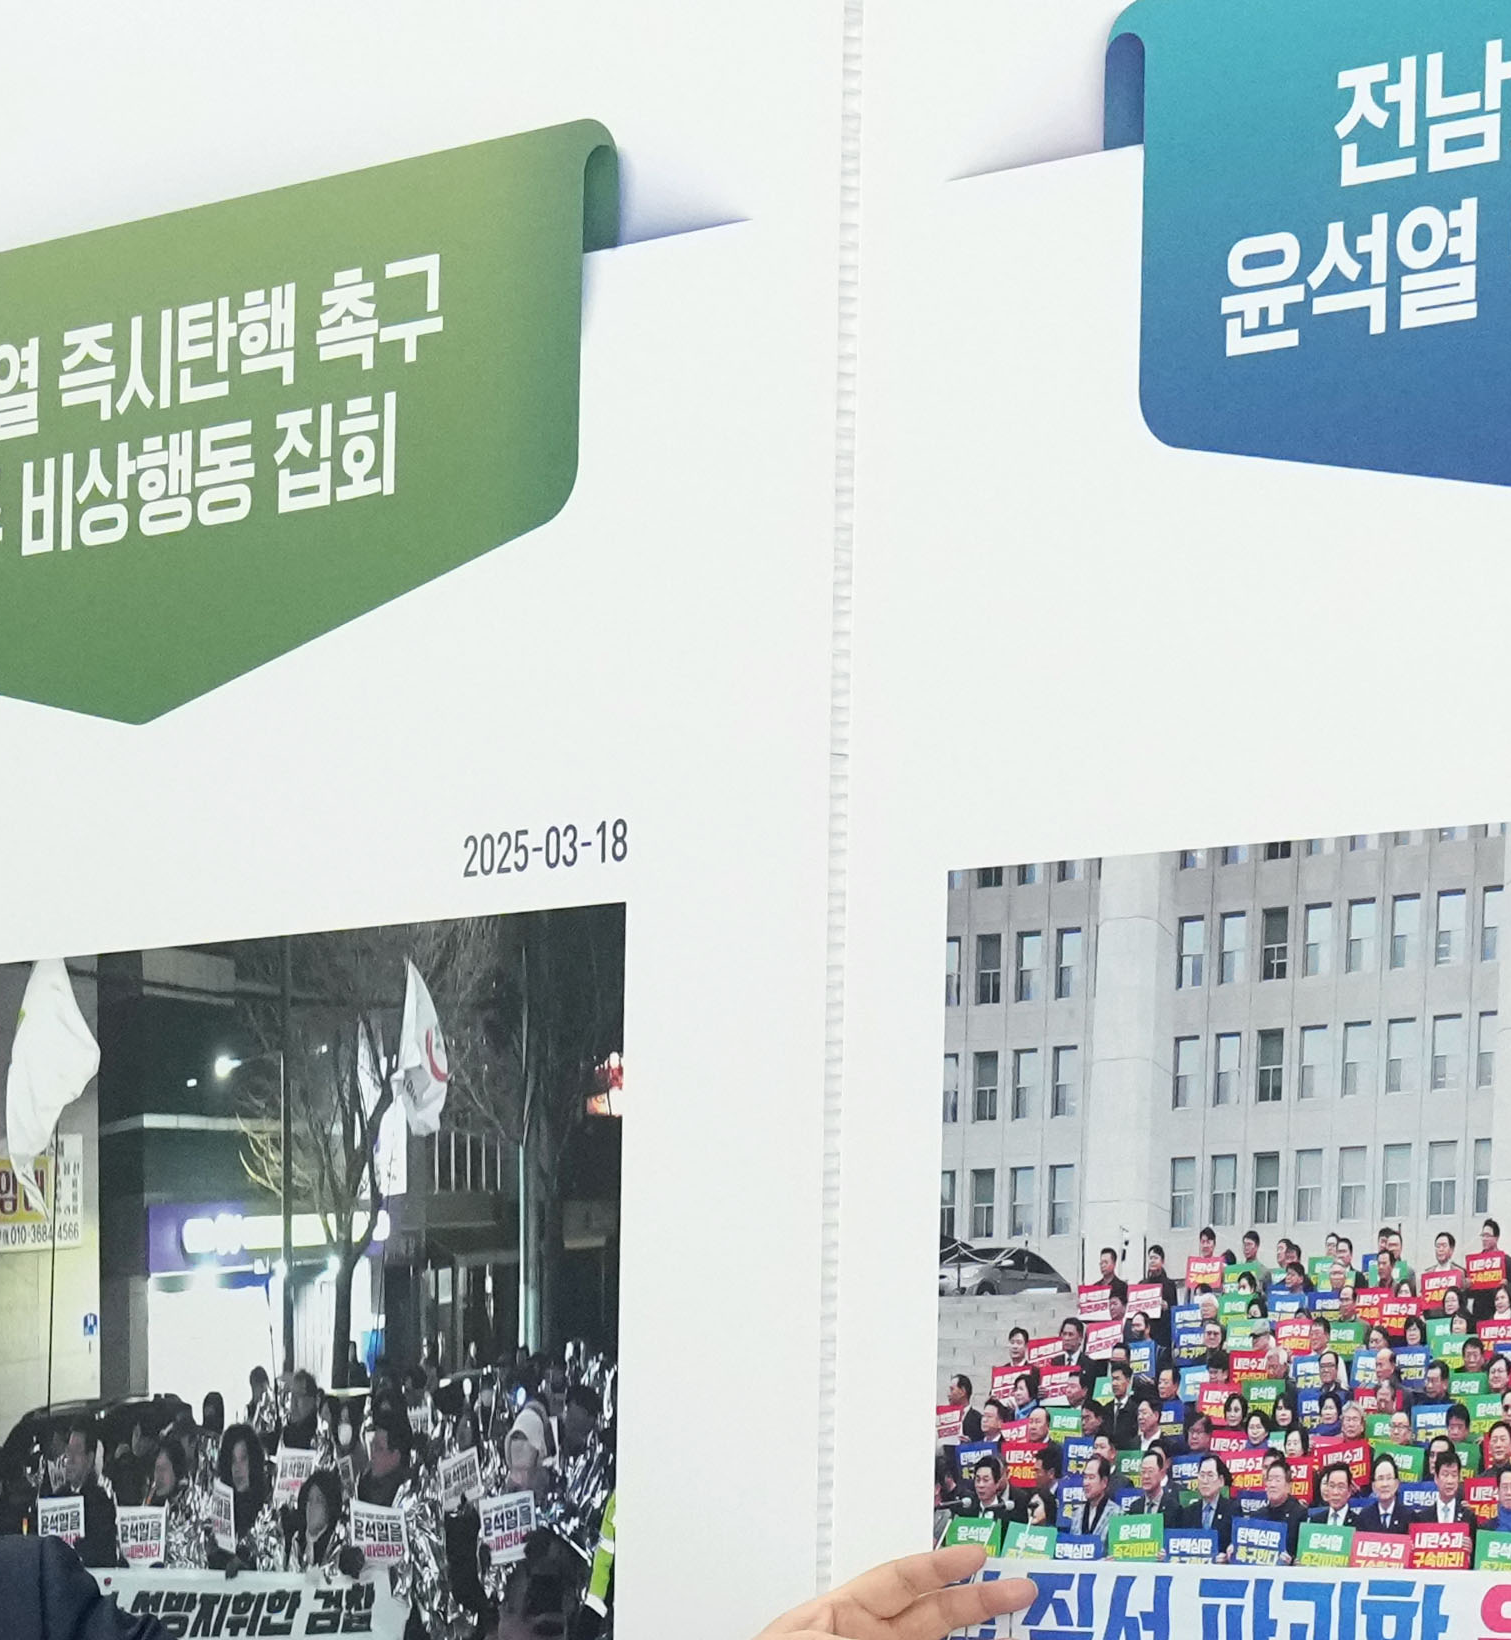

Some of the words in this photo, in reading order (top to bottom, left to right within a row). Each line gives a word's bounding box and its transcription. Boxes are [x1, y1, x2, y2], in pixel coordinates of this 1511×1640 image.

[1221, 197, 1478, 357] 윤석열
[57, 283, 296, 421] 즉시탄핵
[315, 254, 444, 368] 촉구
[20, 421, 254, 558] 비상행동
[273, 392, 397, 514] 집회
[462, 818, 628, 879] 2025-03-18
[1119, 1524, 1152, 1541] 윤석열
[1237, 1527, 1282, 1548] 탄핵심판
[1309, 1533, 1343, 1551] 윤석열
[1415, 1531, 1463, 1550] 내란수괴
[1168, 1537, 1212, 1555] 탄핵심판
[1357, 1541, 1405, 1559] 내란수괴
[305, 1582, 376, 1635] 검찰
